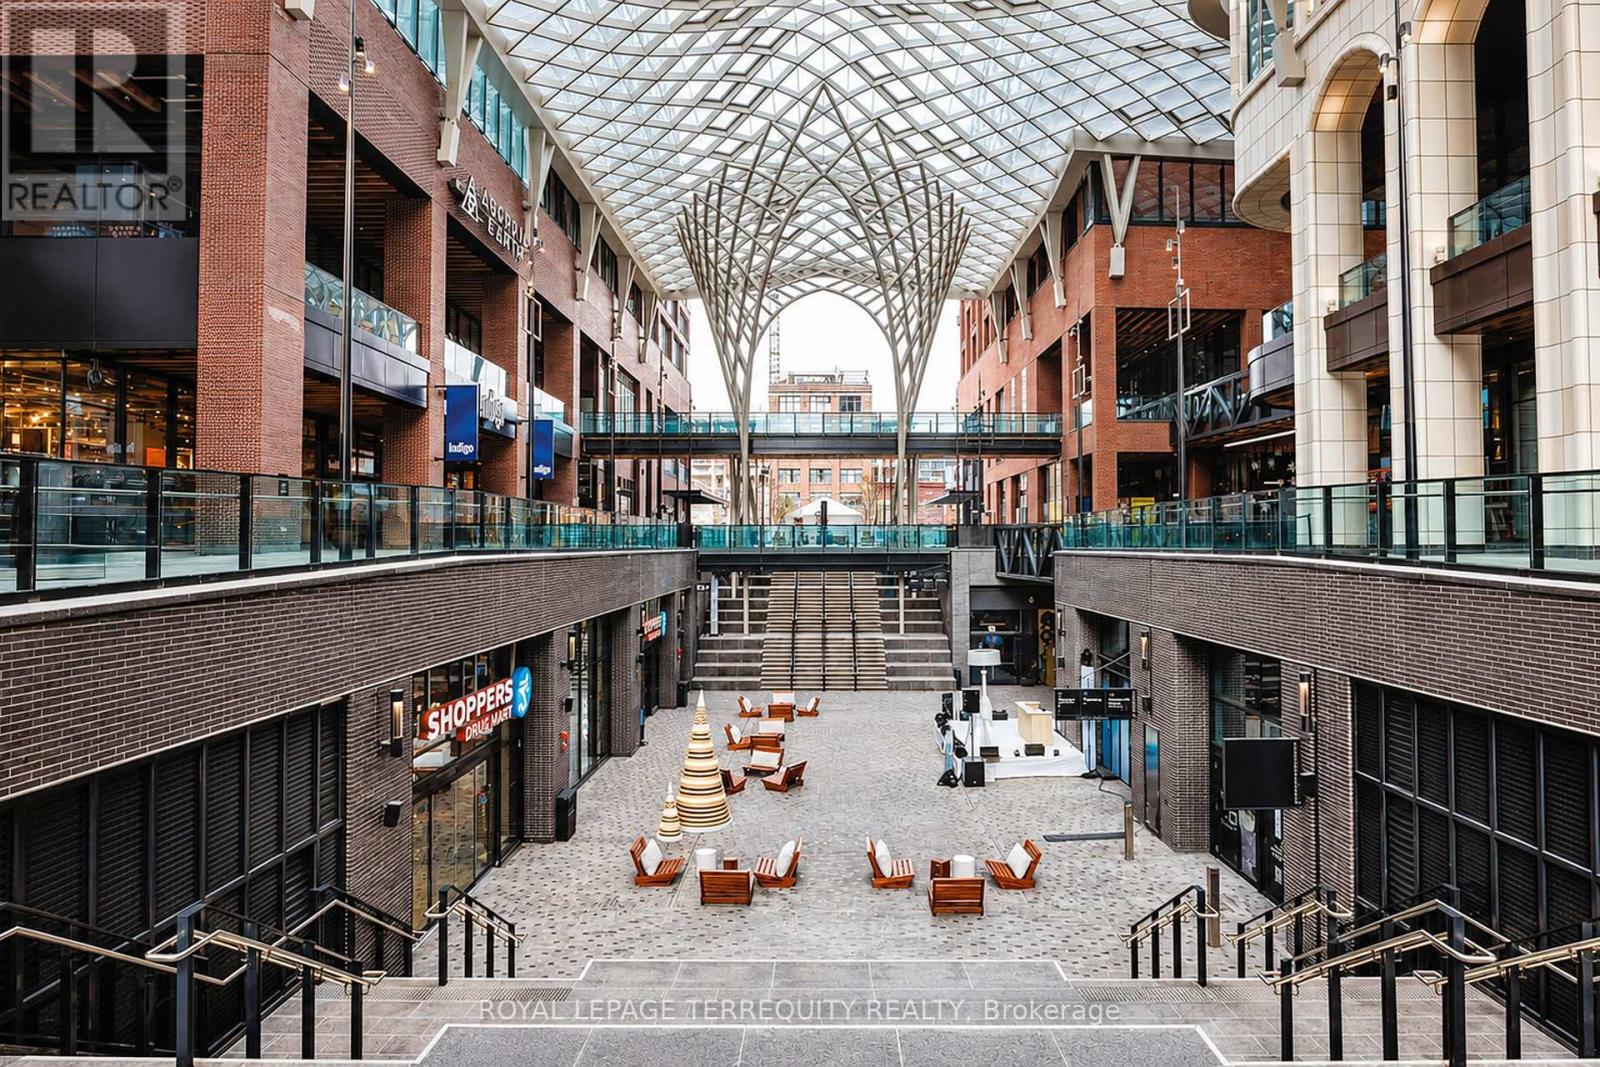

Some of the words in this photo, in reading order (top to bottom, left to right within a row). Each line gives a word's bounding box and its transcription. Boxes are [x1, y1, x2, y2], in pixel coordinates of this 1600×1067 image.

[448, 441, 475, 456] Indigo
[427, 679, 514, 740] SHOPPERS
[465, 716, 492, 742] DRUG
